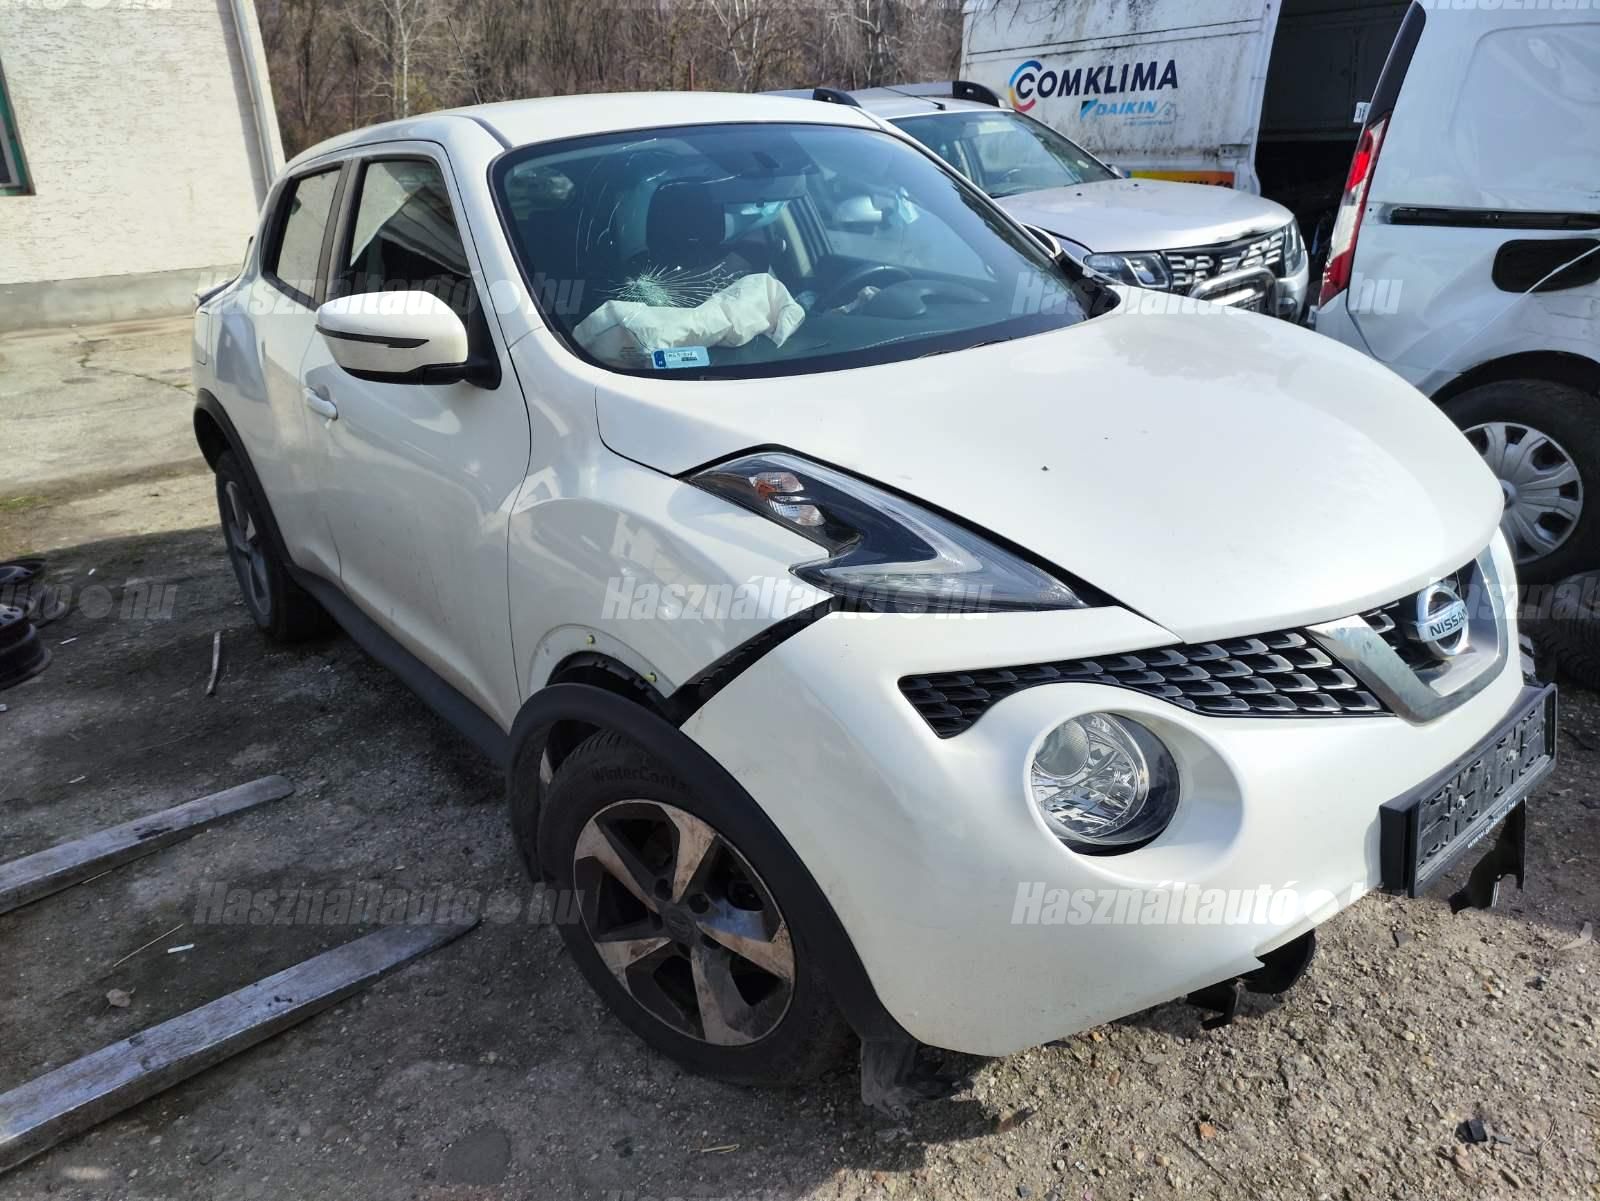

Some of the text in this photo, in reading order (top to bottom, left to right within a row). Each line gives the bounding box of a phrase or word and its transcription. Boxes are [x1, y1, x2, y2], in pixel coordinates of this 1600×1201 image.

[1013, 59, 1179, 100] COMKLIMA
[1095, 100, 1157, 116] DAIKIN
[1429, 607, 1468, 637] NISSAN
